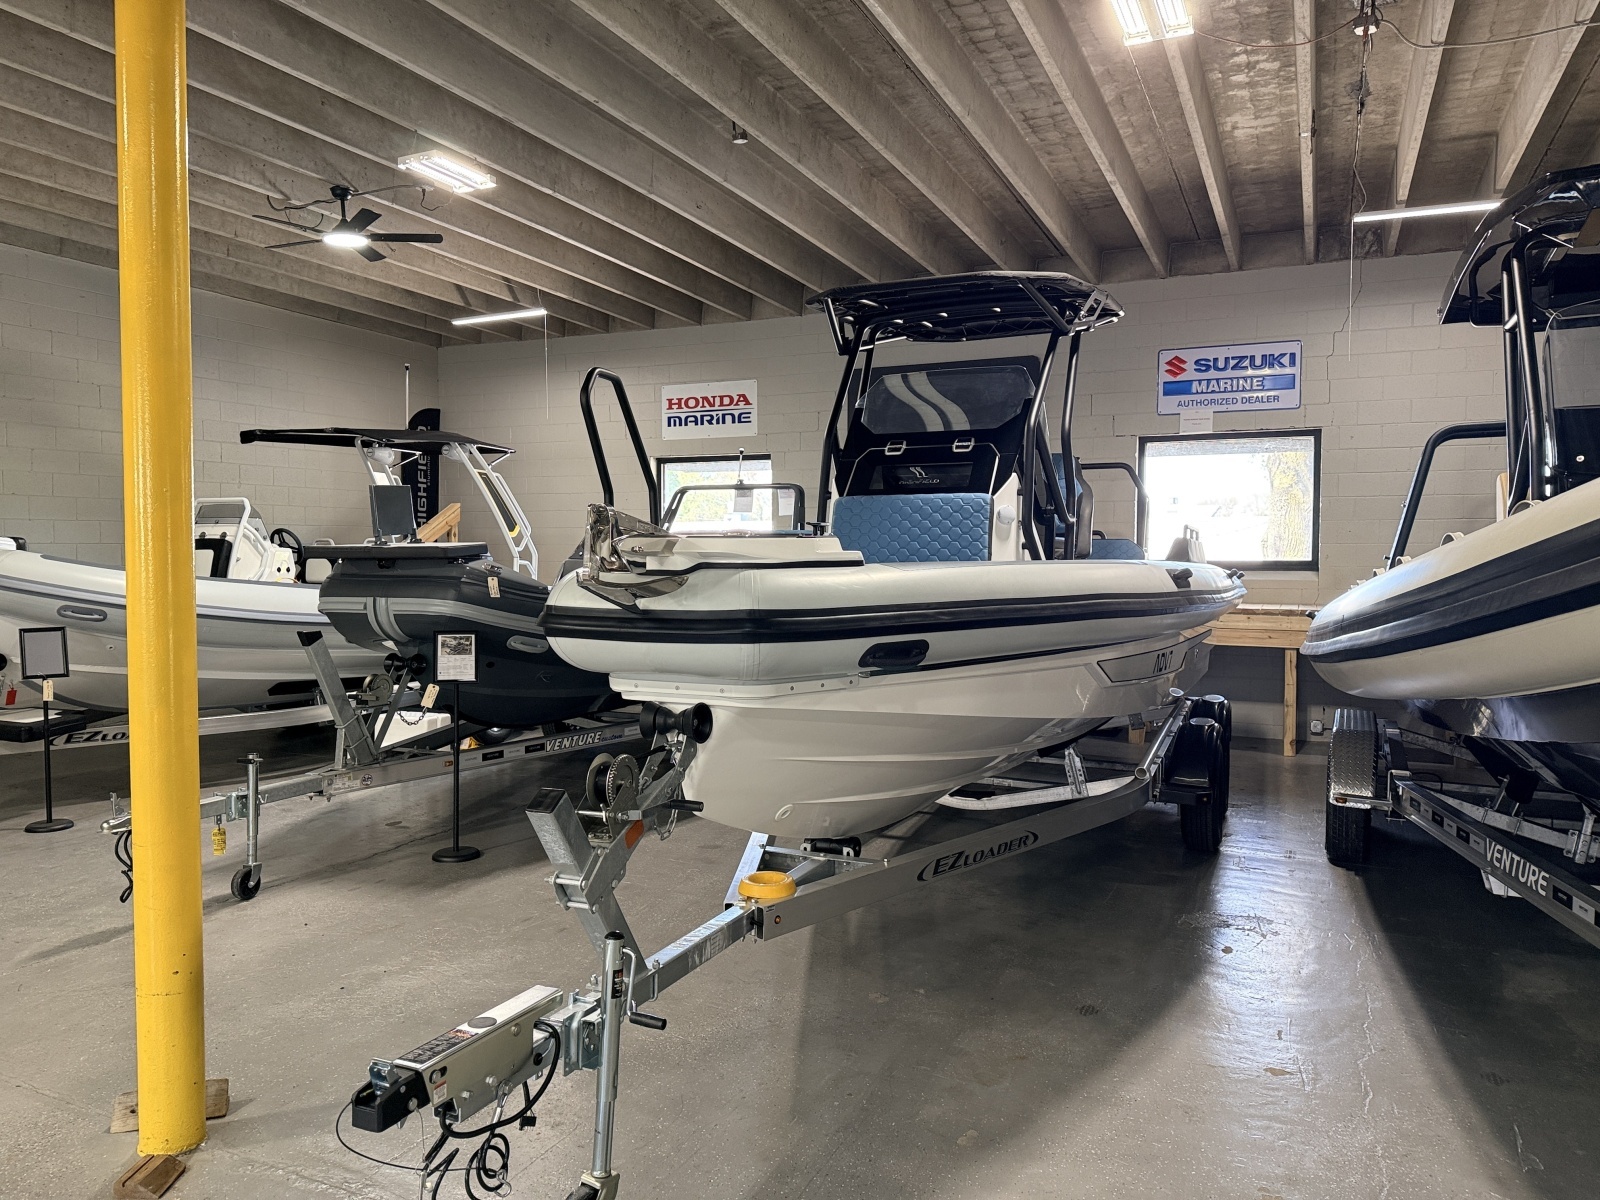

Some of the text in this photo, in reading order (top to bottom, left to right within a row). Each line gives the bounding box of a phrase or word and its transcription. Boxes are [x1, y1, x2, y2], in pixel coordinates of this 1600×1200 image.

[1193, 352, 1296, 373] SUZUKI
[1191, 376, 1265, 394] MARINE
[666, 393, 753, 410] HONDA
[1177, 395, 1280, 408] AUTHORIZED DEALER
[667, 411, 752, 427] MARINE
[63, 730, 129, 745] EZLO
[545, 731, 602, 752] VENTURE
[932, 834, 1030, 878] EZLOADER
[1486, 838, 1549, 896] VENTURE
